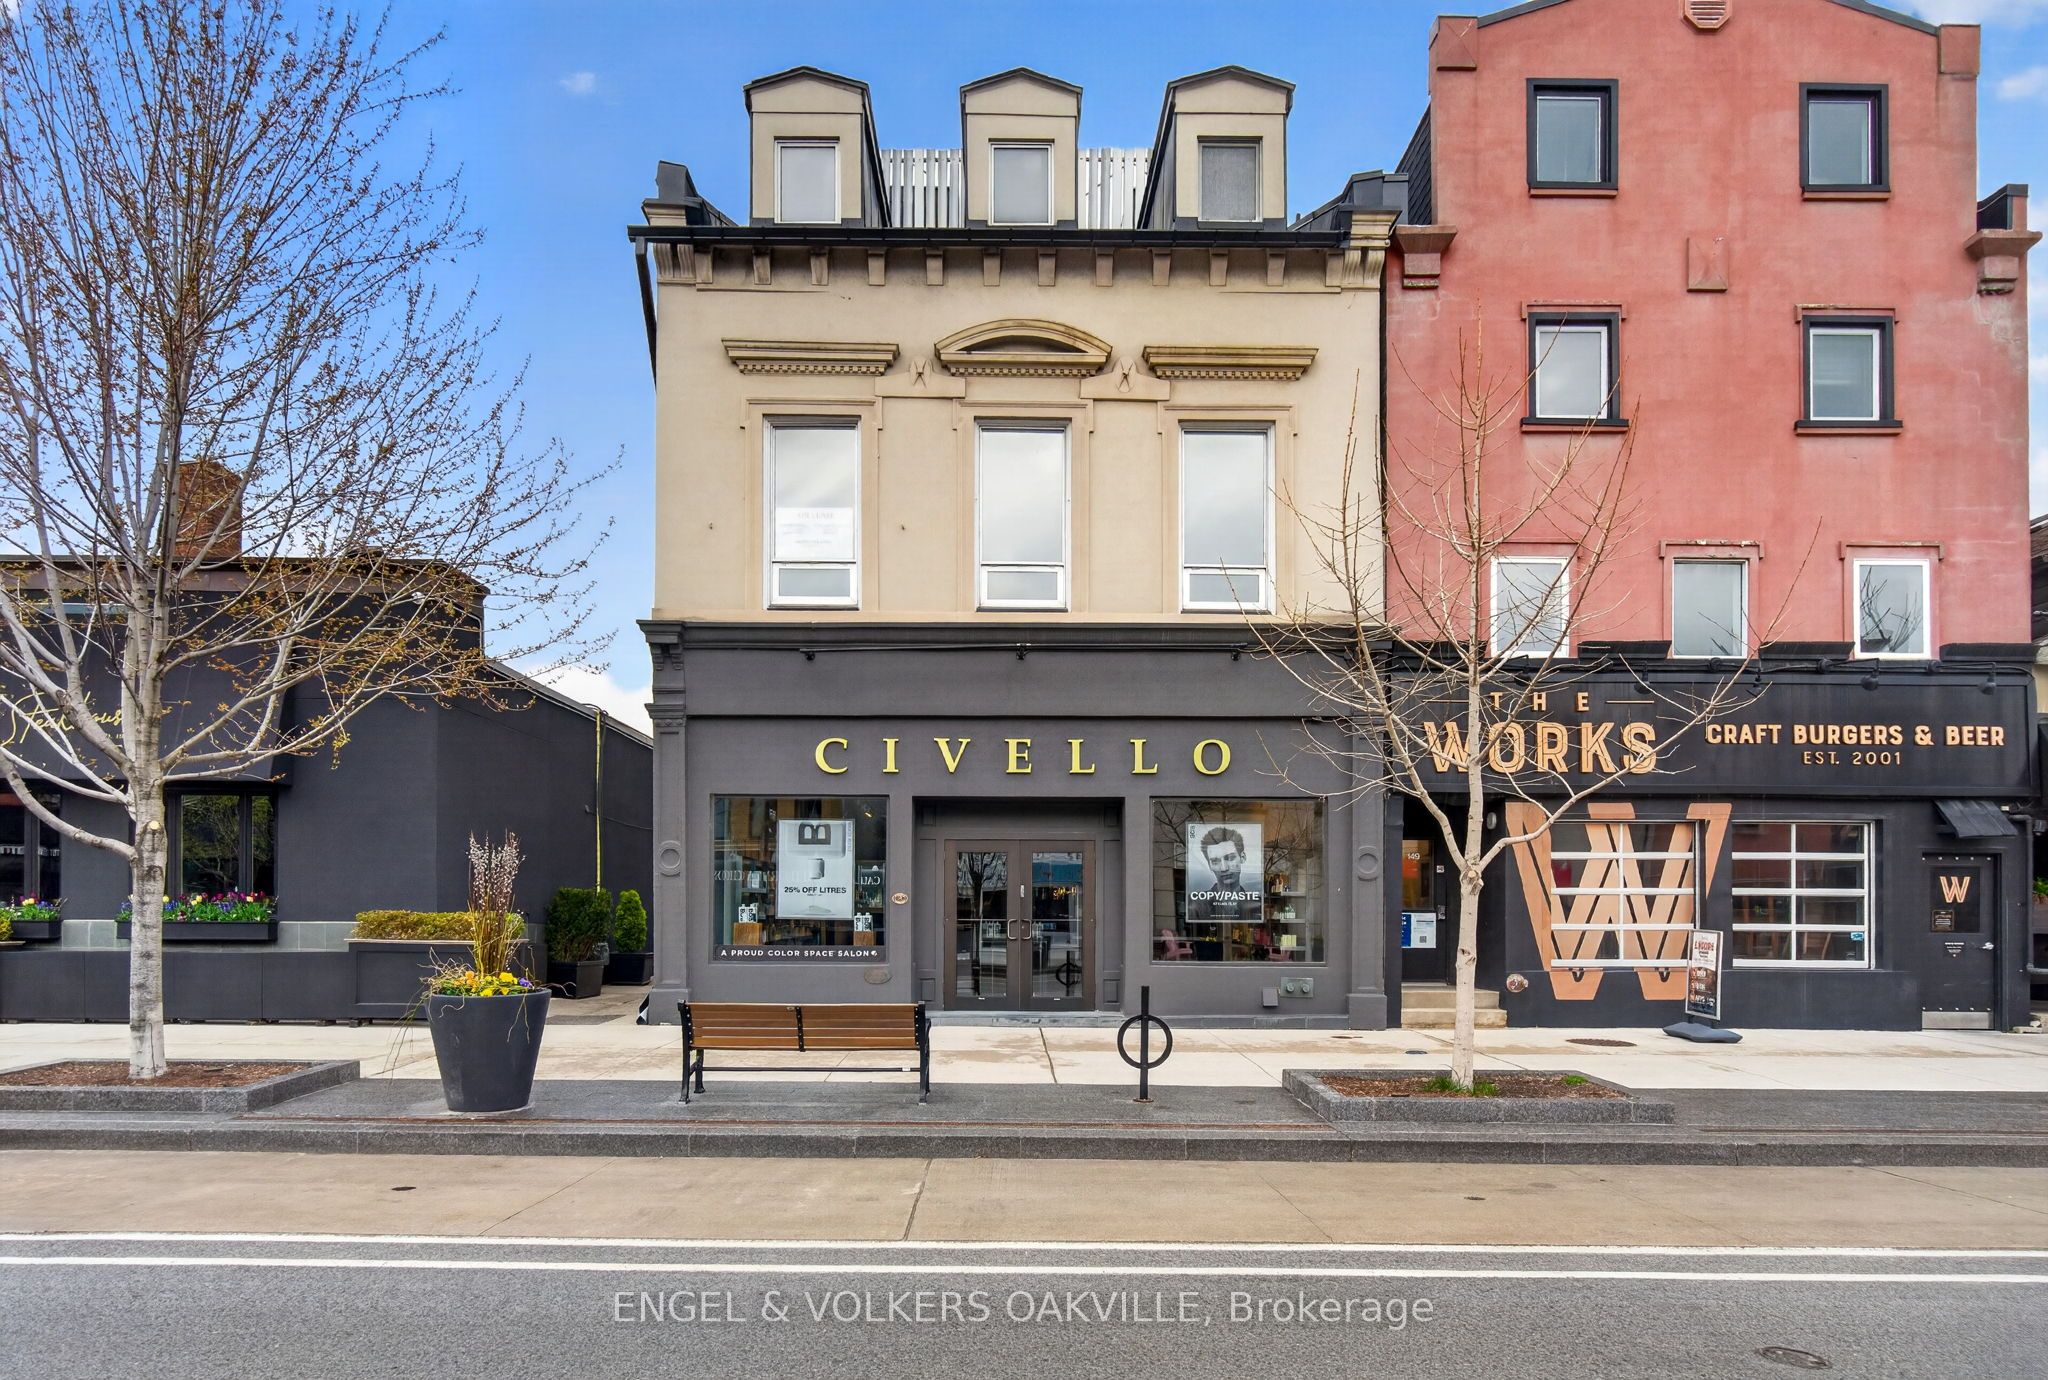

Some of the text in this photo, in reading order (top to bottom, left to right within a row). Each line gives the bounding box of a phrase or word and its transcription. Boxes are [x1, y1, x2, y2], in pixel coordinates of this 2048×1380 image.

[1489, 692, 1589, 712] THE
[1706, 724, 2005, 746] CRAFT BURGERS & BEER
[814, 737, 1231, 776] CIVELLO
[1424, 721, 1657, 774] WORKS
[1803, 751, 1901, 766] EST. 2001
[1190, 891, 1260, 901] COPY/PASTE
[1940, 876, 1971, 903] W
